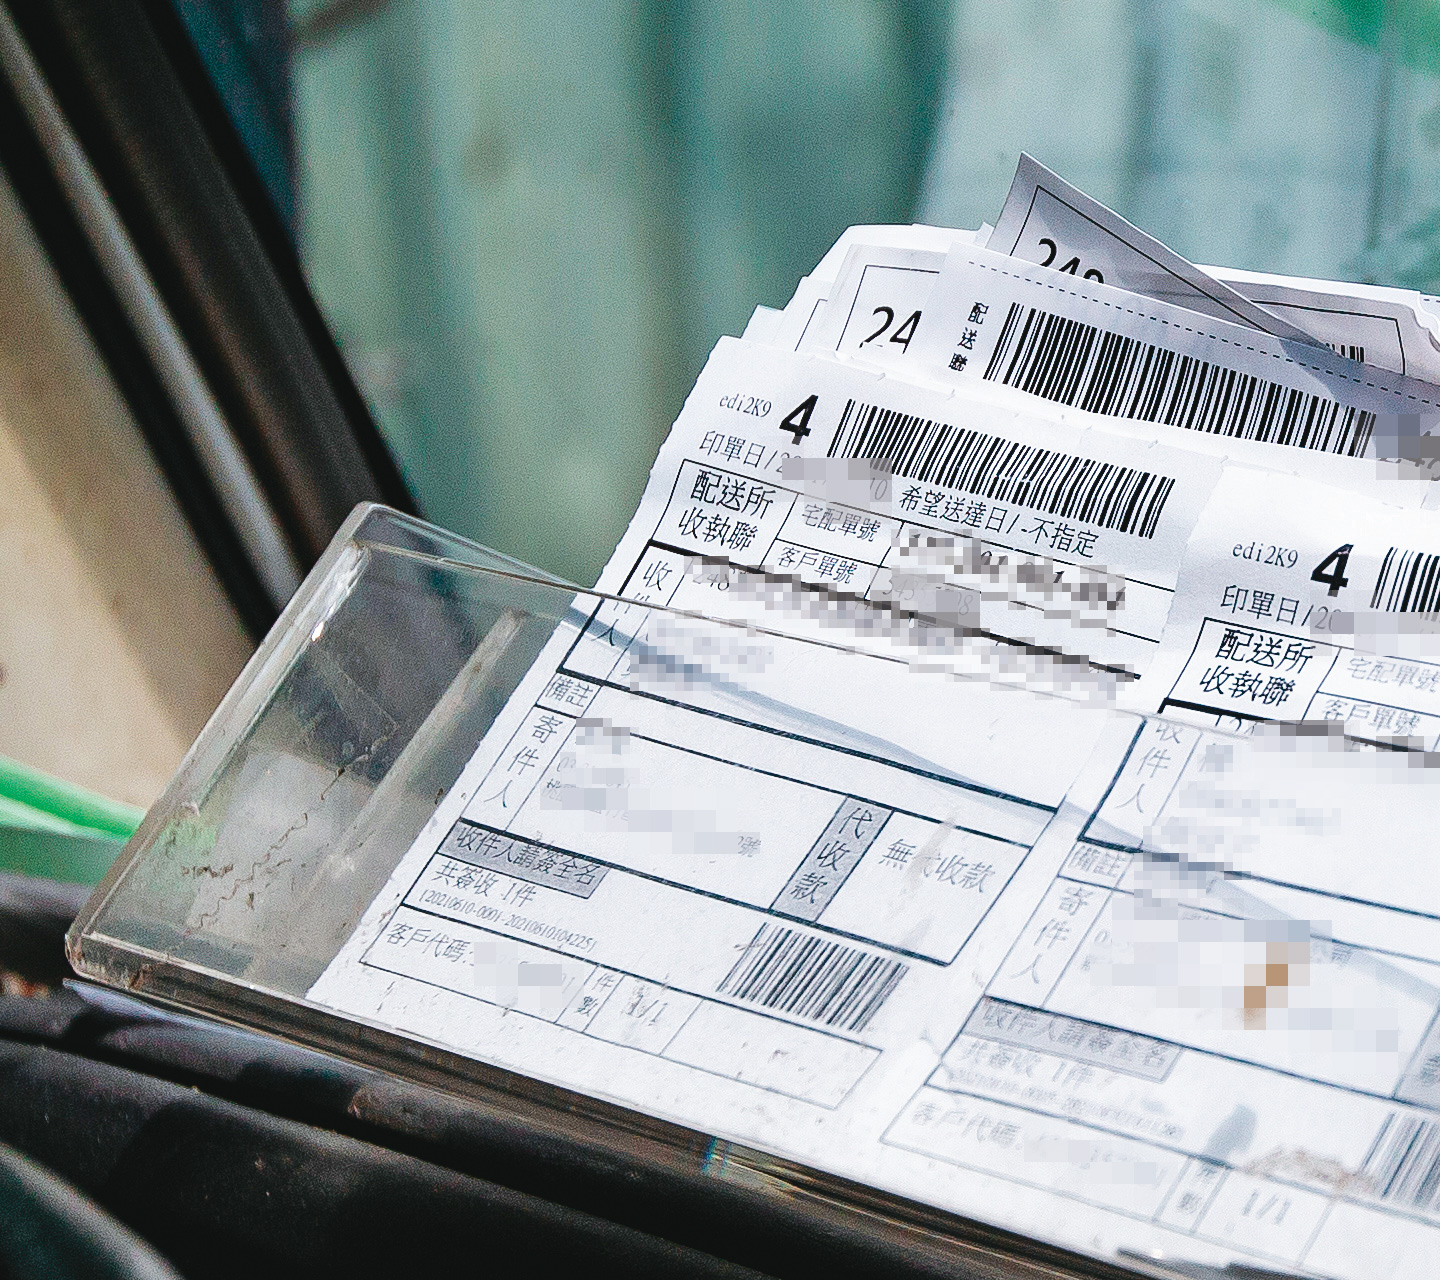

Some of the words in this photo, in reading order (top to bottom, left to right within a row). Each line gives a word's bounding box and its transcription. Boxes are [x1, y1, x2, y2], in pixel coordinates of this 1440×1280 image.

[718, 393, 773, 419] edi2K9
[778, 393, 820, 446] 4
[689, 468, 777, 520] 配送所
[677, 506, 759, 553] 收執聯
[801, 503, 882, 543] 宅配單號
[1231, 541, 1299, 570] edi2K9
[1310, 543, 1355, 597] 4
[1214, 627, 1317, 675] 配送所
[1198, 663, 1297, 708] 收執聯
[482, 714, 564, 810] 寄件人
[789, 806, 873, 905] 代收款
